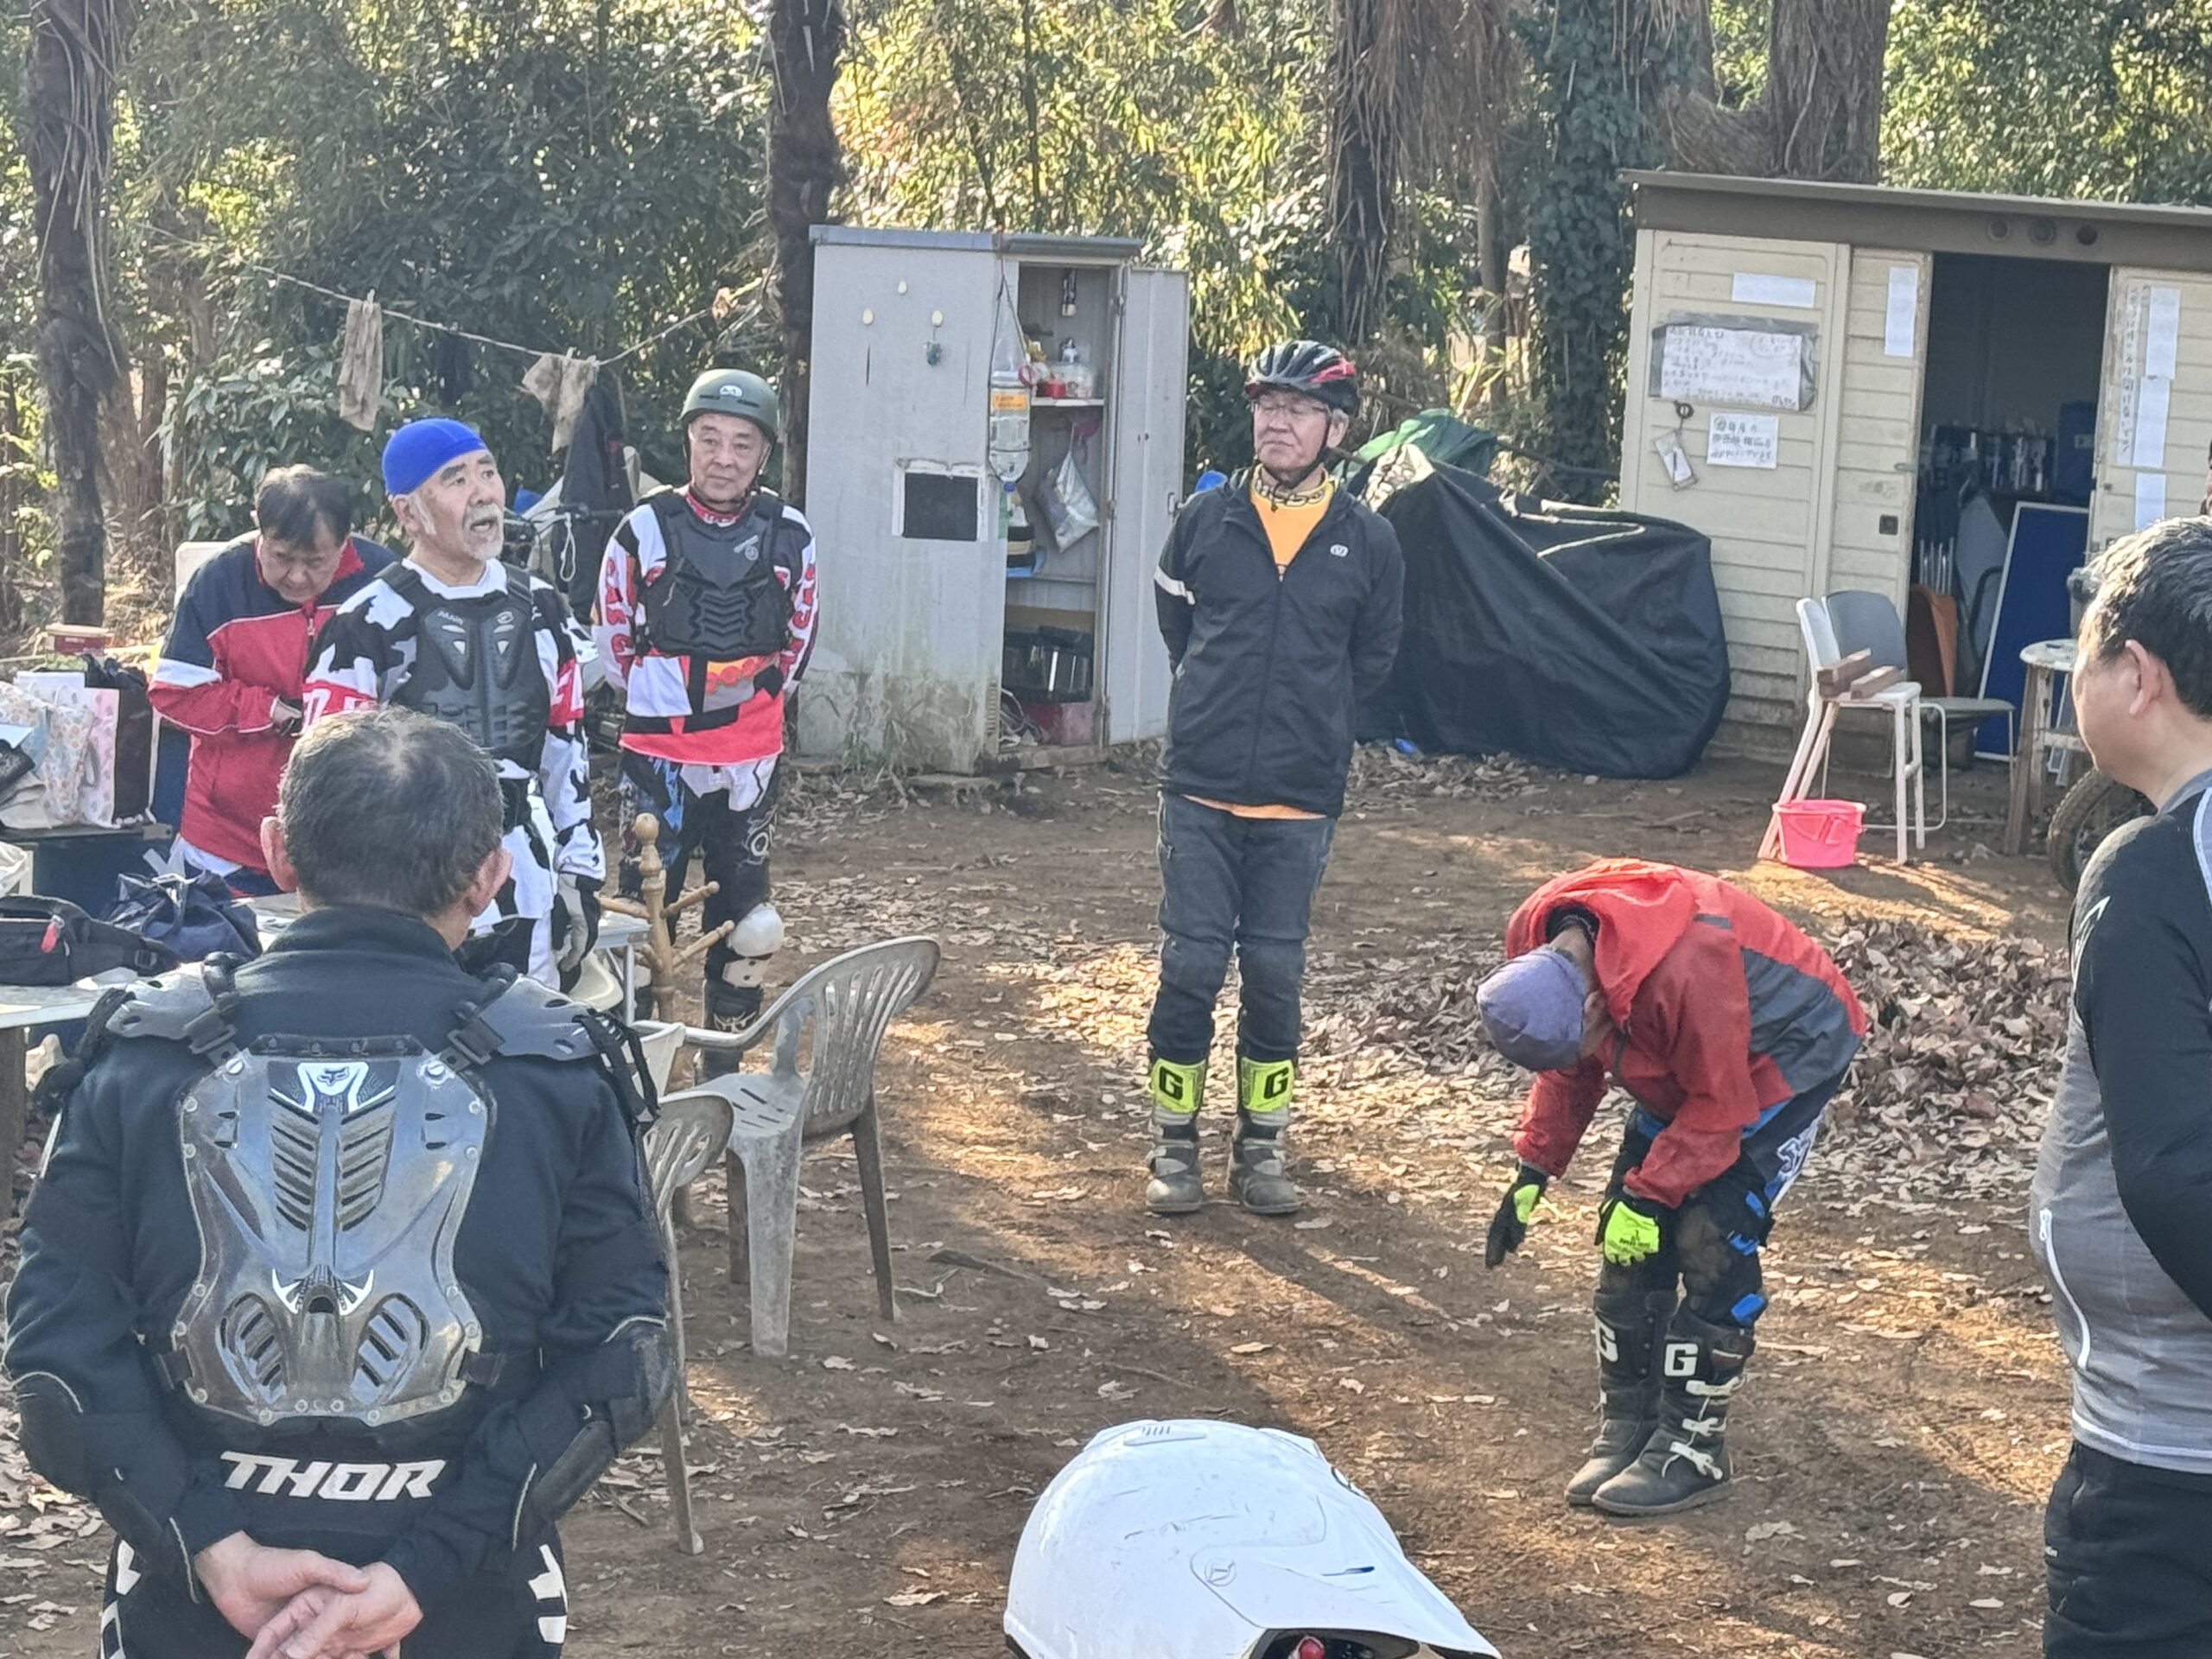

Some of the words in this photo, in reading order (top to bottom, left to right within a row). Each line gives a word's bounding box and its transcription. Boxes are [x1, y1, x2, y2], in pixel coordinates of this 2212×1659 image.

[1160, 1066, 1184, 1100] G
[1264, 1066, 1289, 1099] G
[1664, 1343, 1699, 1376] G
[220, 1451, 447, 1501] THOR
